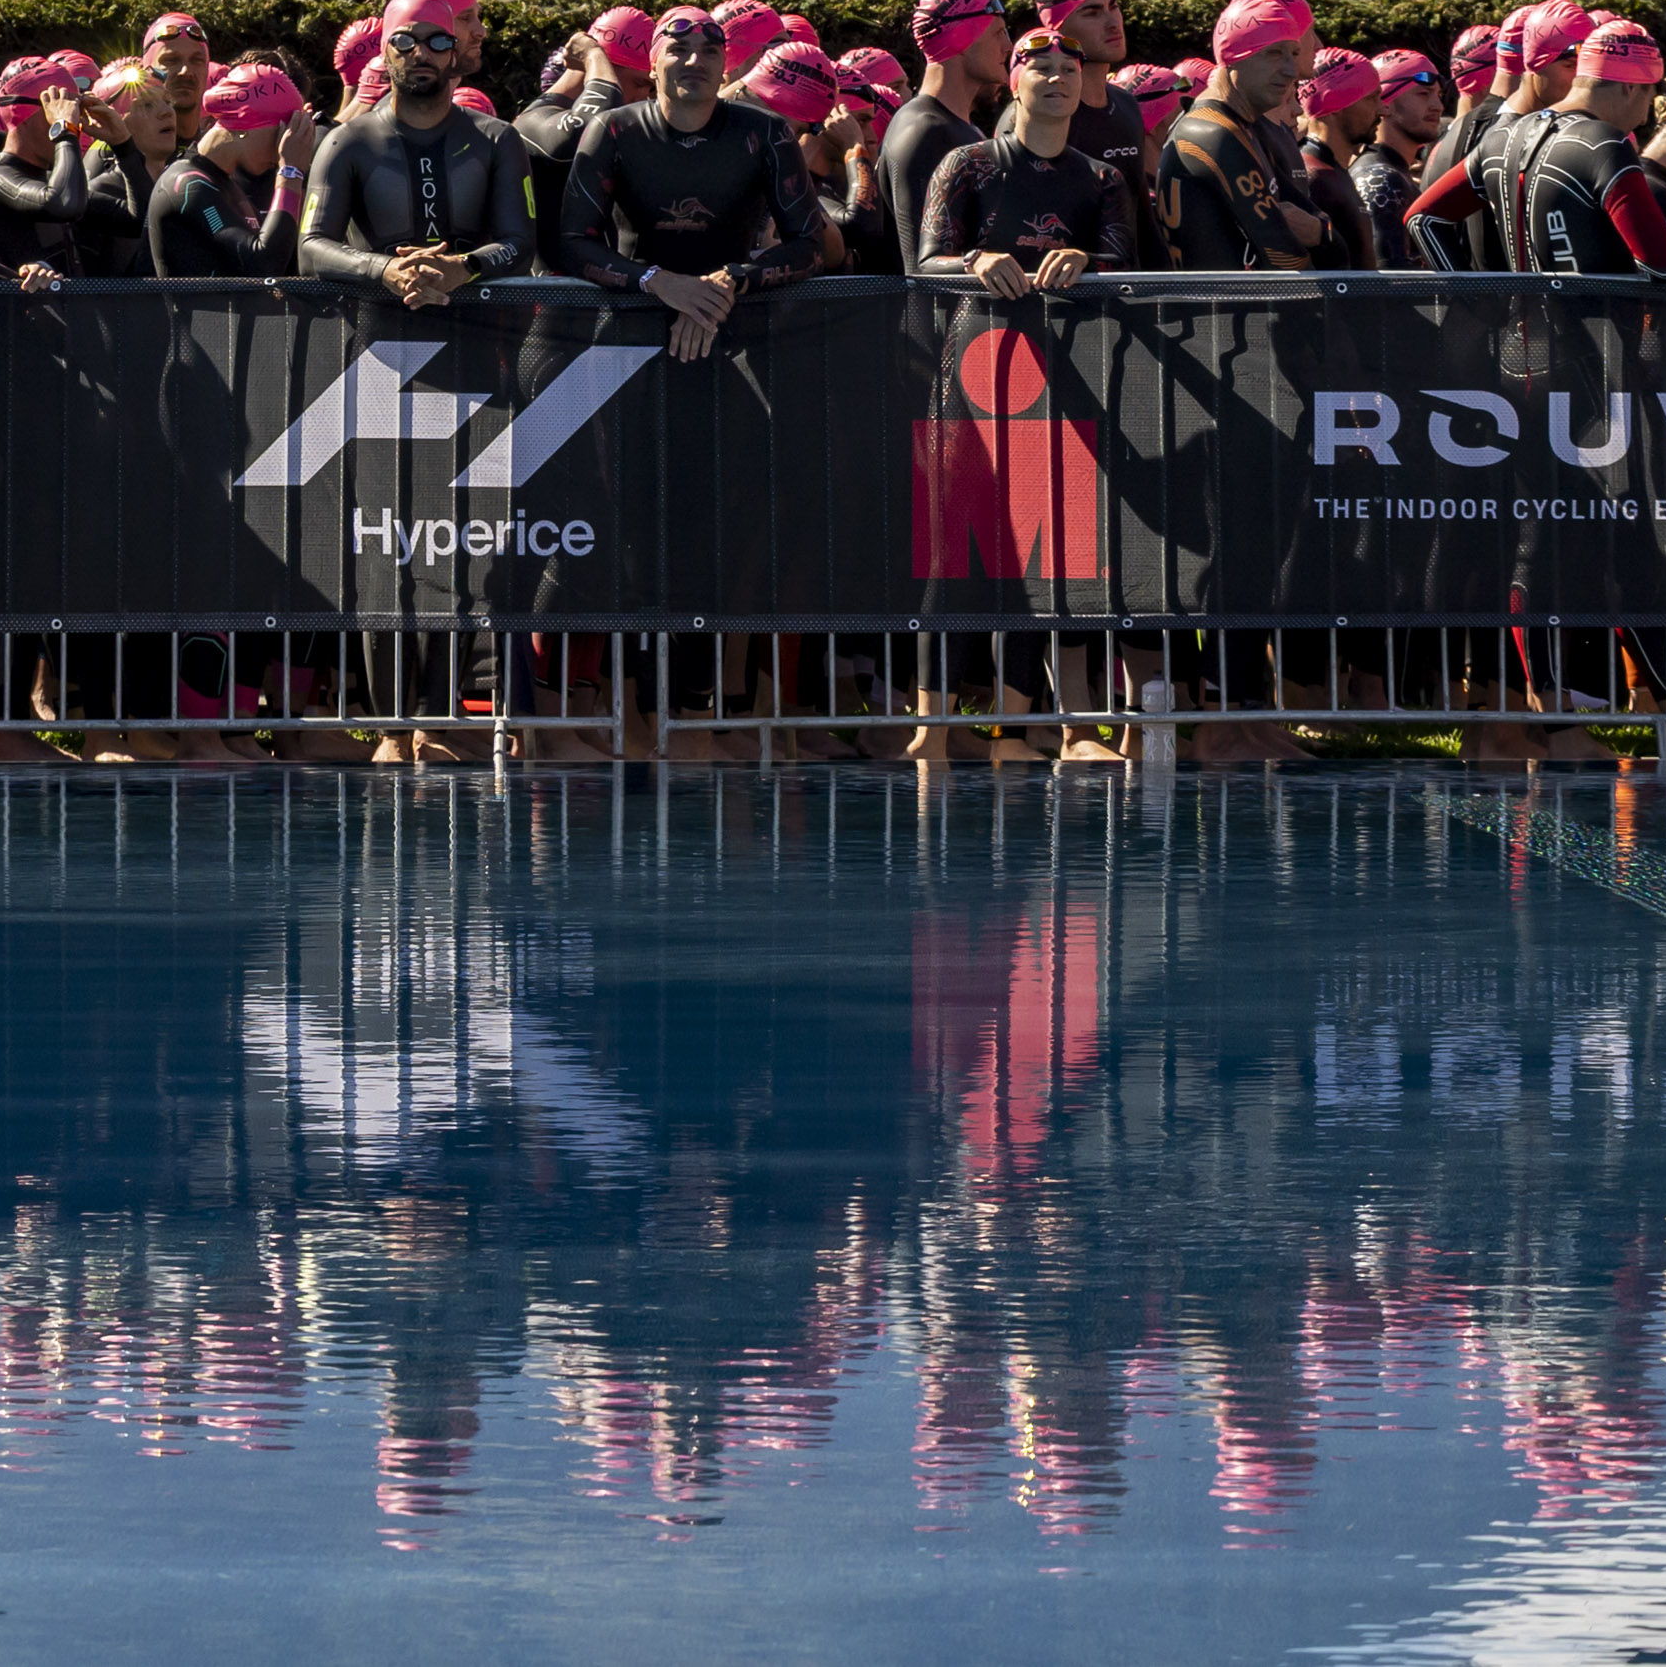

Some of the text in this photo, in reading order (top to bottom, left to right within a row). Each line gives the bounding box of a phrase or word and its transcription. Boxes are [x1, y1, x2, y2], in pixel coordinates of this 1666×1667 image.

[1102, 146, 1139, 159] orca
[1314, 497, 1371, 520] THE
[1385, 498, 1499, 521] INDOOR
[1513, 498, 1639, 521] CYCLING
[352, 507, 596, 566] Hyperice
